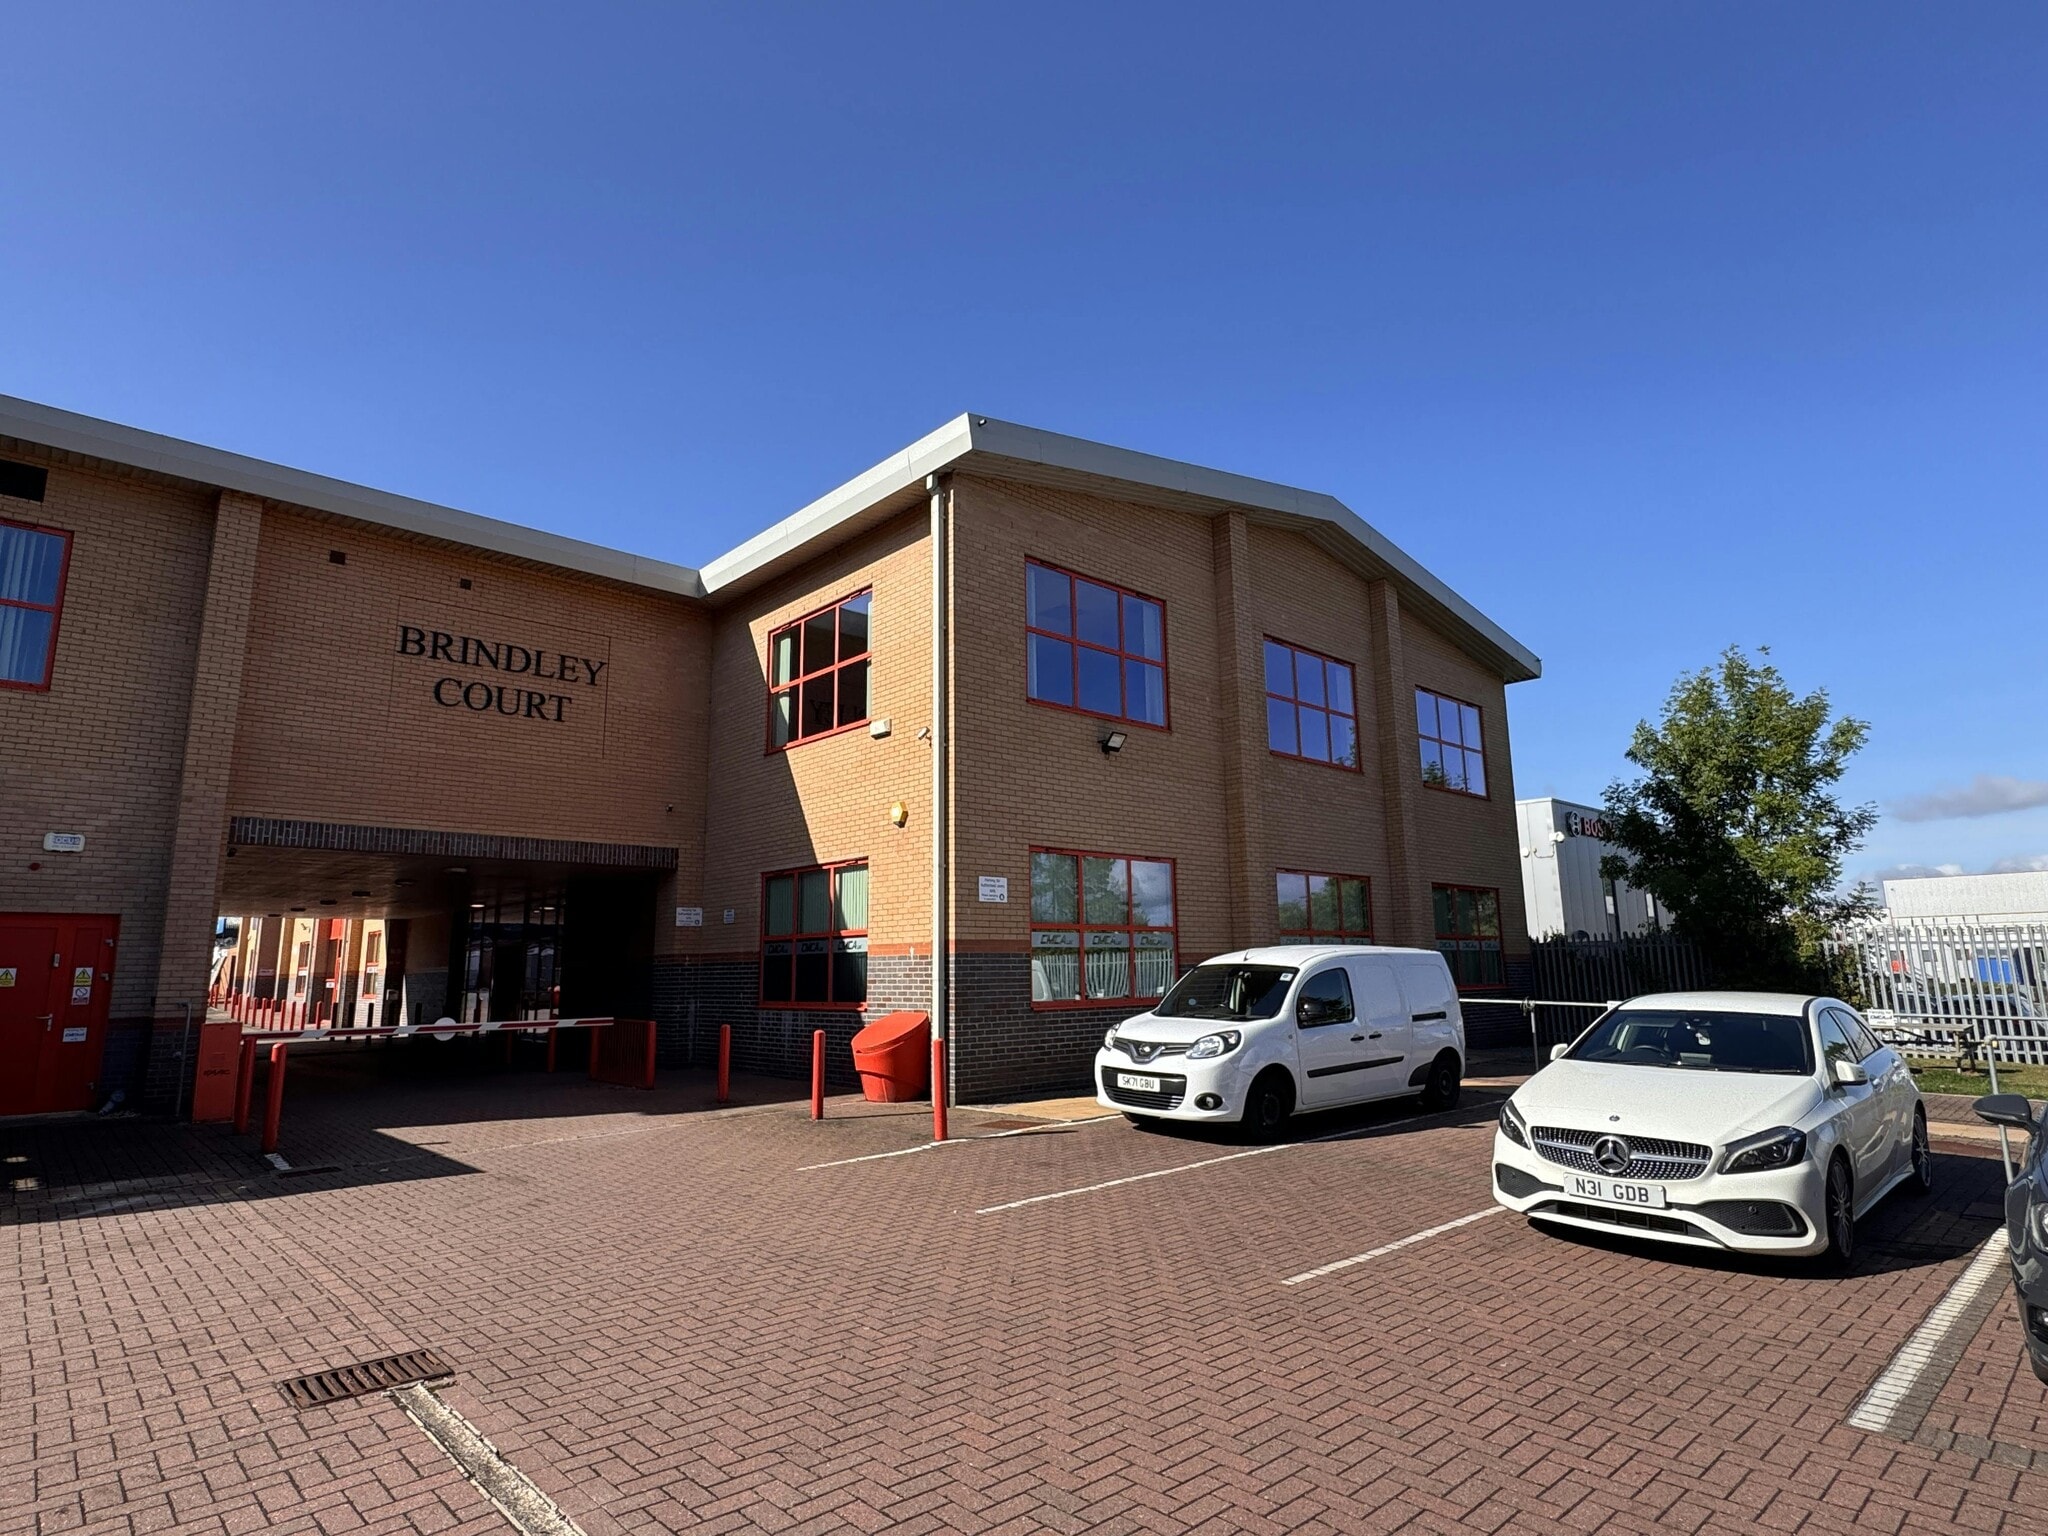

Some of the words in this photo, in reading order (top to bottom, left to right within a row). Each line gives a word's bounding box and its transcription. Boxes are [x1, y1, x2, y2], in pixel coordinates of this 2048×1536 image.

[397, 625, 608, 687] BRINDLEY
[433, 677, 573, 723] COURT
[1122, 1076, 1138, 1087] SK71
[1139, 1078, 1155, 1089] GBU
[1575, 1178, 1602, 1197] N31
[1613, 1184, 1649, 1203] GDB
